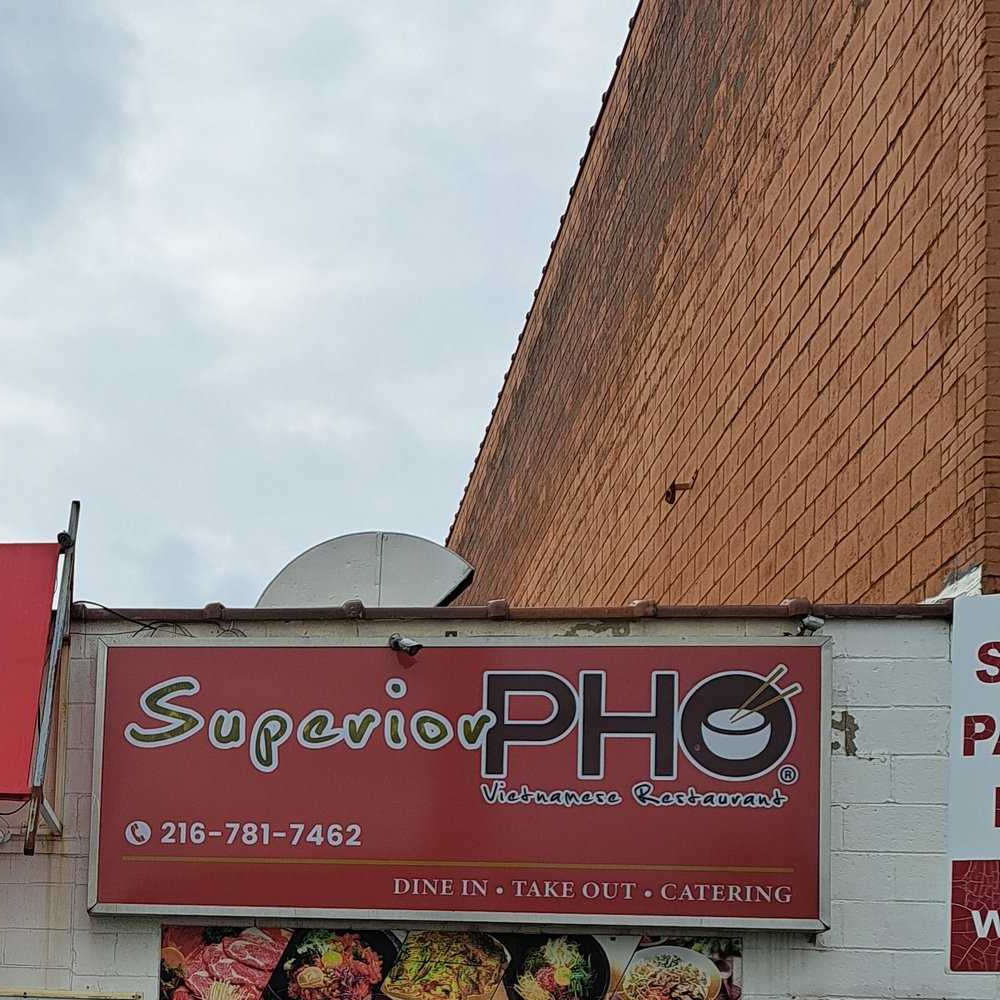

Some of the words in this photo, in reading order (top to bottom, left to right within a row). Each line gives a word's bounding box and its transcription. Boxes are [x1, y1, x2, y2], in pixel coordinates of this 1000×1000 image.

[124, 676, 496, 772] Superior
[480, 669, 797, 782] PHO
[481, 781, 623, 808] Vietnamese
[632, 781, 790, 810] Restaurant
[160, 820, 363, 848] 216-781-7462
[393, 876, 456, 897] DINE
[460, 878, 490, 898] IN
[511, 879, 575, 900] TAKE
[580, 880, 637, 901] OUT
[659, 882, 792, 904] CATERING
